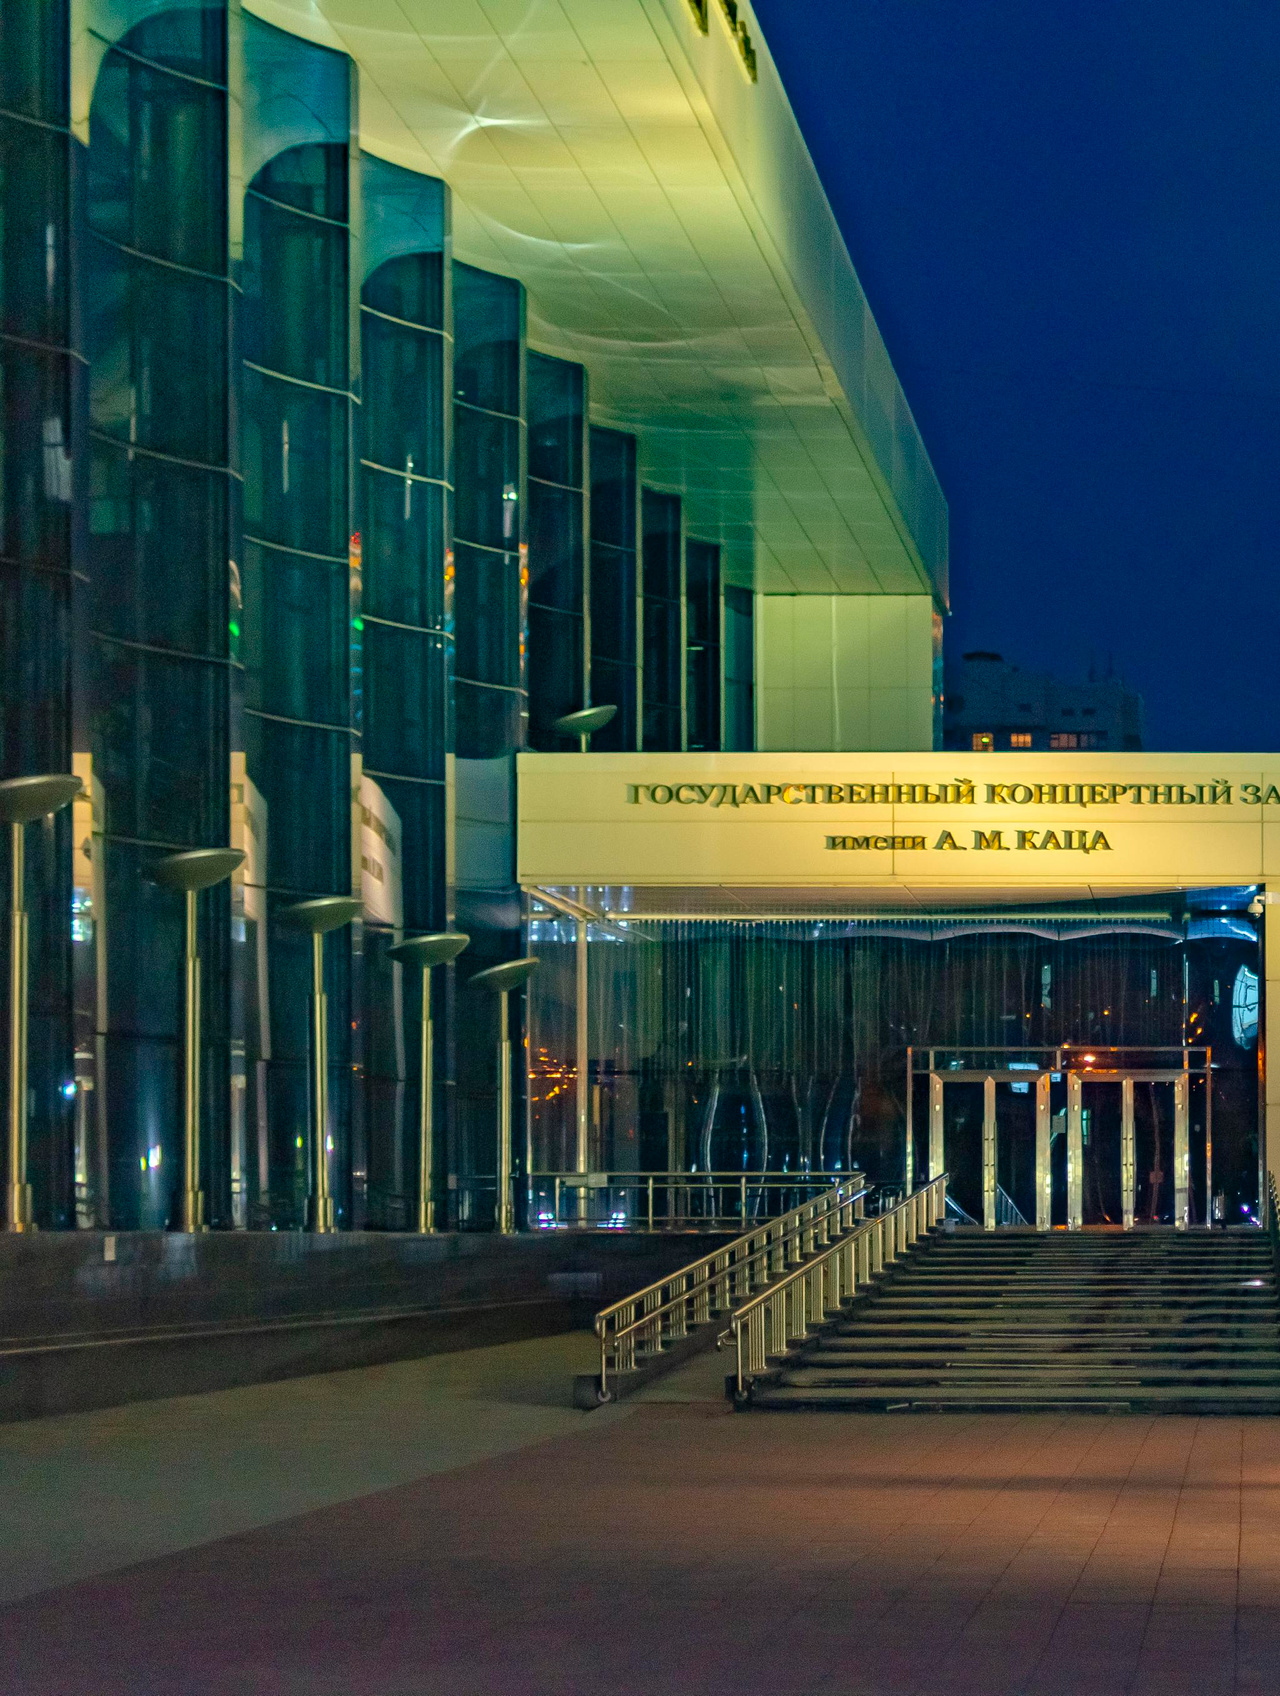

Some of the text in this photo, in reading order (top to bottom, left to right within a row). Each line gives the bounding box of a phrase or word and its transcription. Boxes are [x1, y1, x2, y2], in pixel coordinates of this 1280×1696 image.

[626, 778, 976, 809] ГОСУДАРСТВЕННЫЙ
[984, 778, 1234, 808] КОНЦЕРТНЫЙ
[824, 834, 928, 851] имени
[1014, 829, 1114, 854] КАЦА
